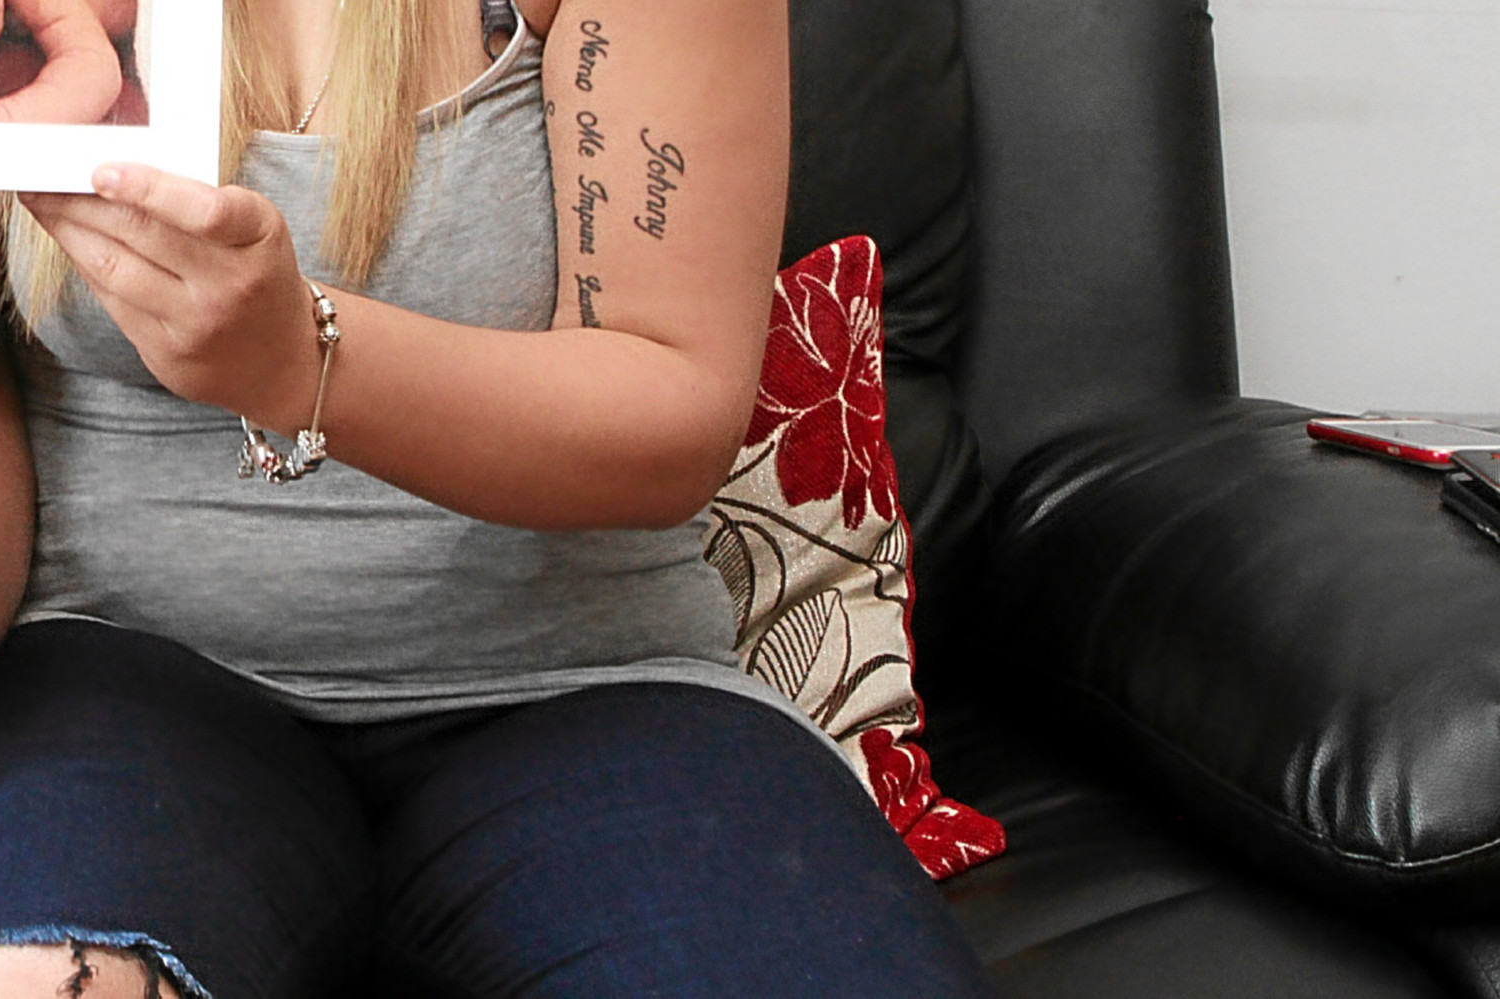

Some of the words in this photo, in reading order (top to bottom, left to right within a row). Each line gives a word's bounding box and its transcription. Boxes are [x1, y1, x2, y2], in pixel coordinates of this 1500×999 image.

[575, 19, 610, 92] Nemo
[577, 110, 605, 158] Me
[571, 174, 608, 255] Impune
[635, 128, 684, 241] Johnny
